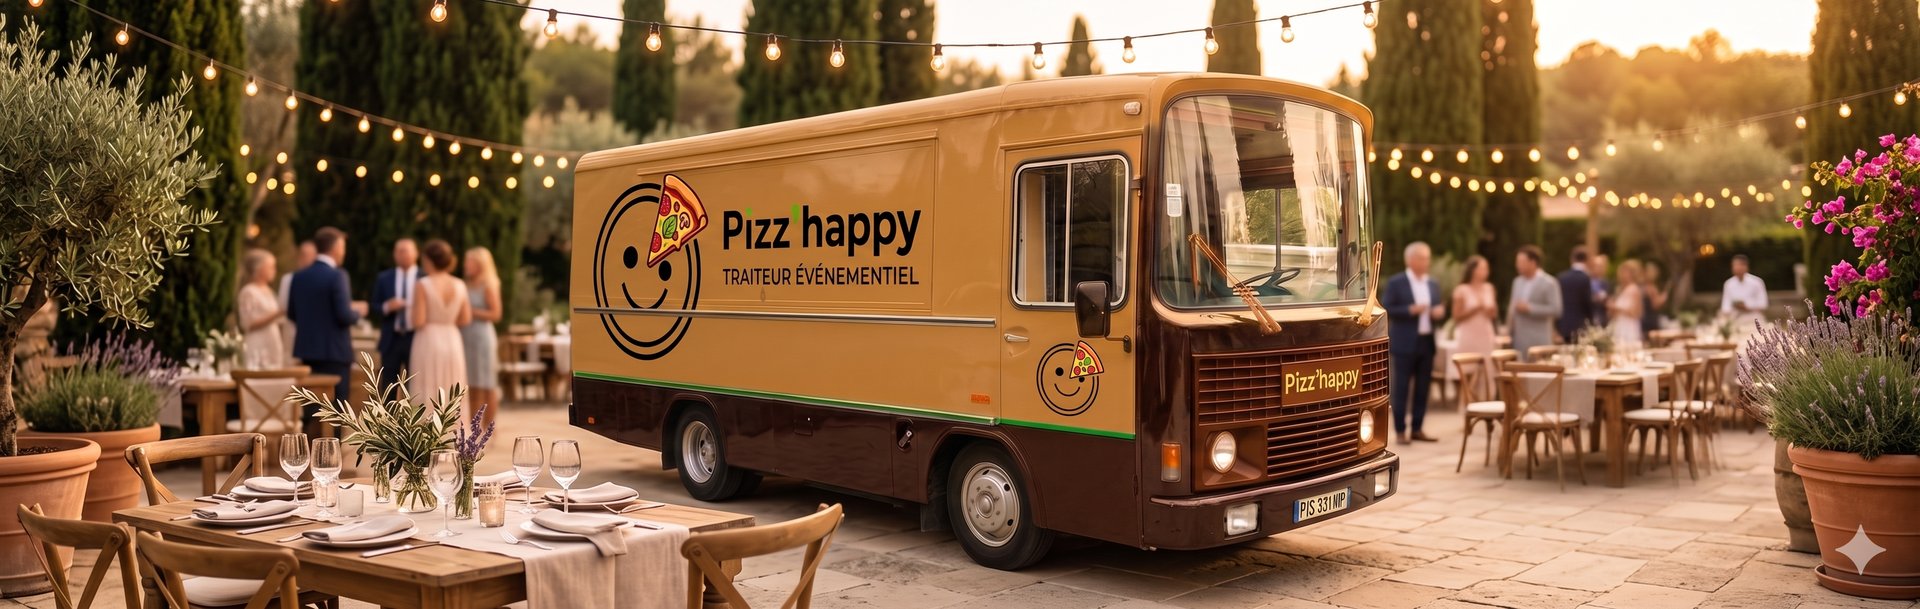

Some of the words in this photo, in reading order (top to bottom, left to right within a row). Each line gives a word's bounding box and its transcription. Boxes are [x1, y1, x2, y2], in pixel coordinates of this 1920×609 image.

[723, 203, 921, 257] Pizz'happy
[723, 268, 791, 285] TRAITEUR
[796, 263, 919, 285] ÉVÉNEMENTIEL
[1285, 369, 1359, 394] Pizz'happy
[1300, 500, 1315, 518] PIS
[1317, 496, 1332, 513] 331
